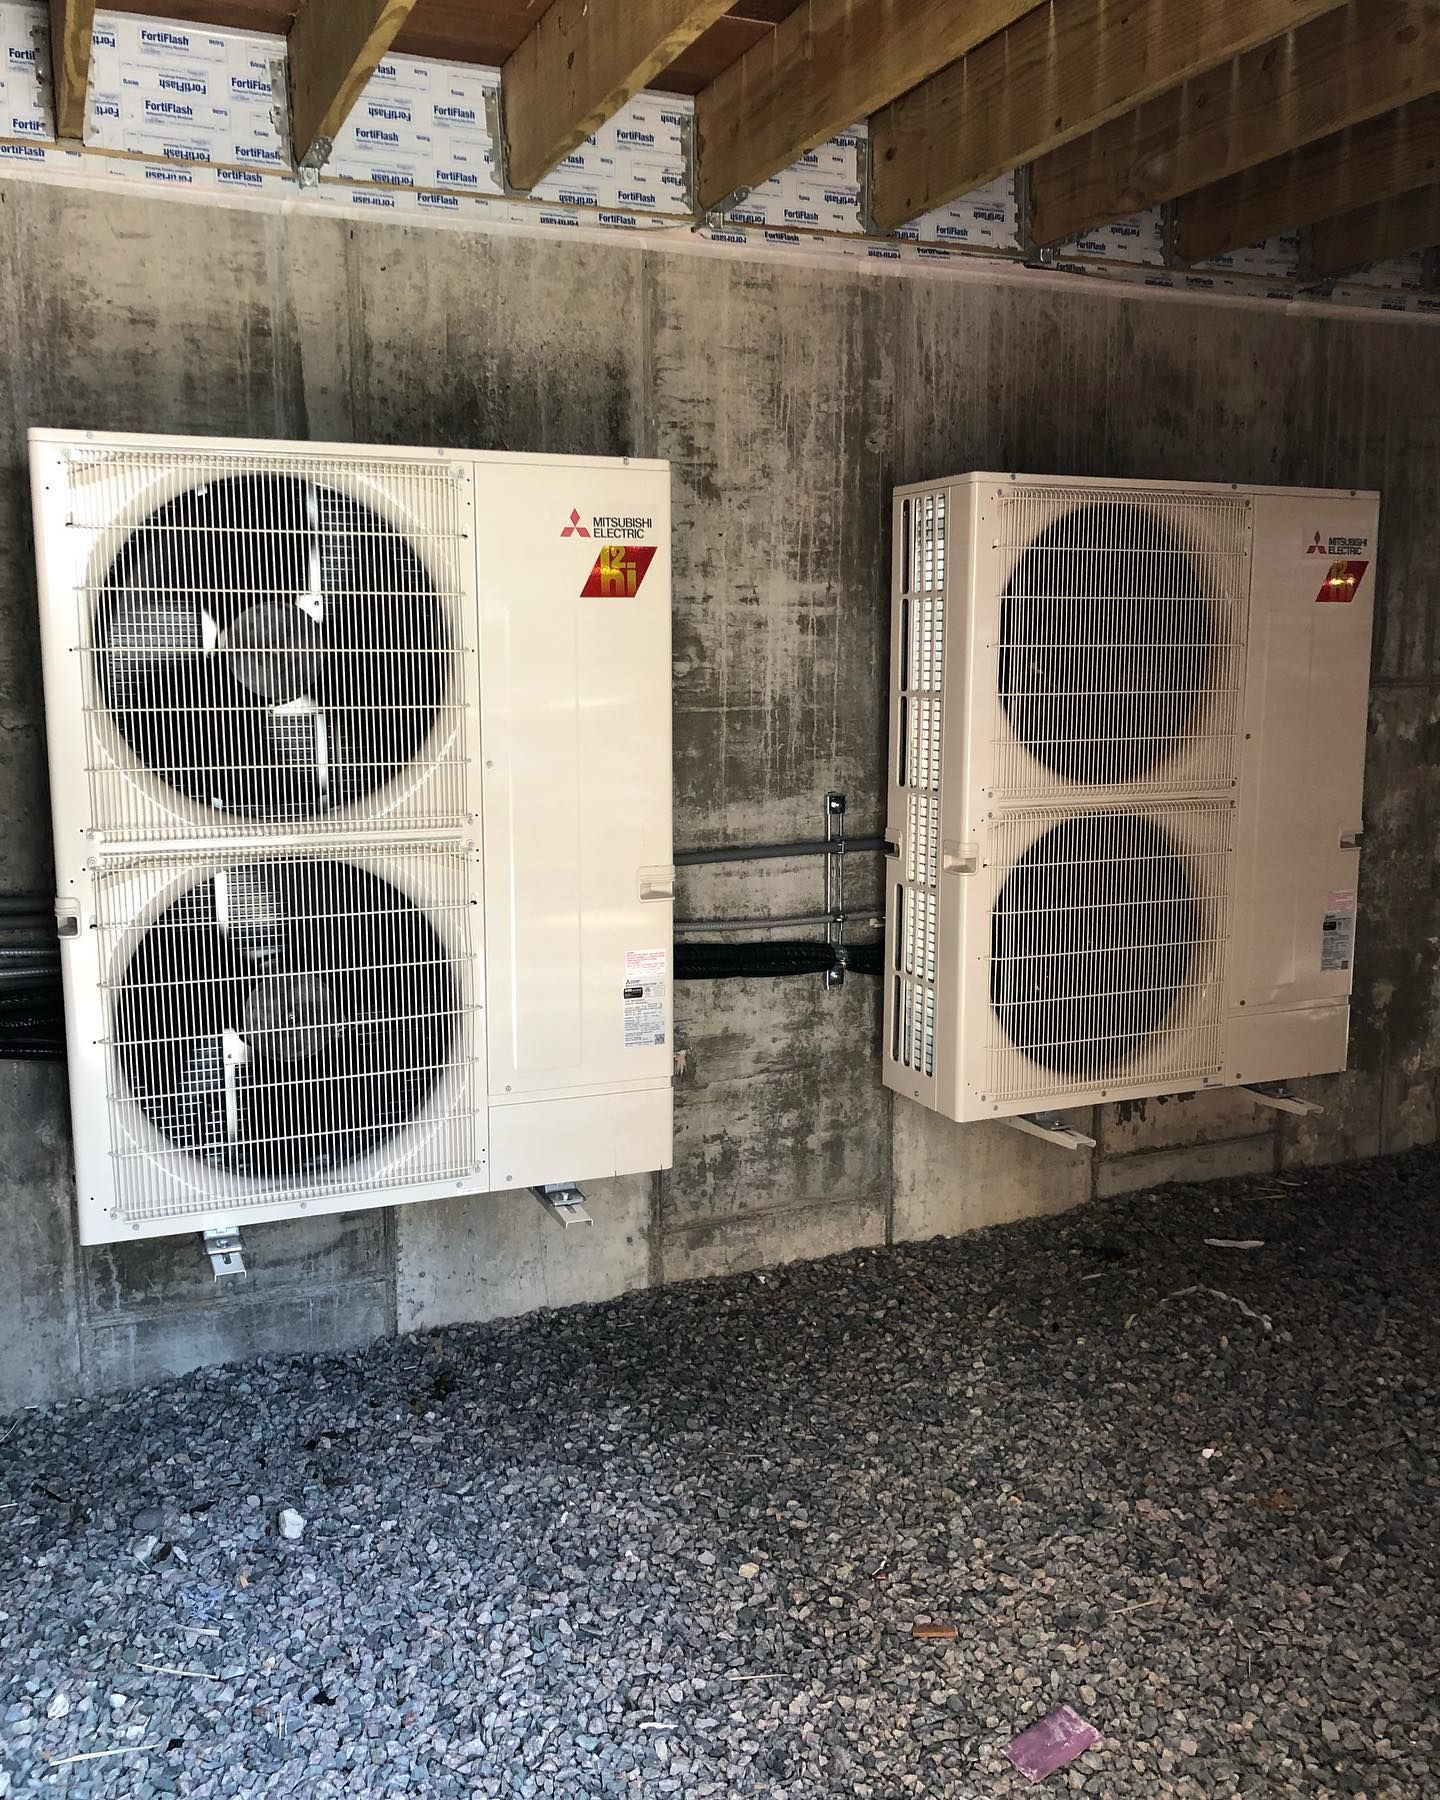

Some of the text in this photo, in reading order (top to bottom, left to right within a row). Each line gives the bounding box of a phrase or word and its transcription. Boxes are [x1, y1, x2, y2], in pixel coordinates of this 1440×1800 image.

[141, 30, 189, 46] FortiFlash
[159, 79, 207, 95] FortiFlash
[231, 77, 272, 93] FortiFlas
[145, 99, 193, 116] FortiFlash
[368, 106, 412, 122] FortiFlash
[434, 104, 476, 120] FortiFlash
[356, 127, 399, 142] FortiFlash
[617, 129, 655, 143] FortiFlash
[0, 144, 45, 158] ortiFlash
[235, 145, 282, 161] FortiFlash
[217, 168, 263, 184] FortiFlash
[436, 169, 478, 184] FortiFlash
[417, 192, 459, 206] FortiFlash
[618, 190, 656, 204] FortiFlash
[598, 213, 636, 226] FortiFlash
[784, 208, 819, 221] FortiFlash
[936, 225, 968, 237] FortiFlash
[593, 517, 653, 529] MITSUBISHI
[593, 528, 645, 539] ELECTRIC
[1328, 537, 1368, 547] MITSUBISHI
[1328, 546, 1362, 556] ELECTRIC
